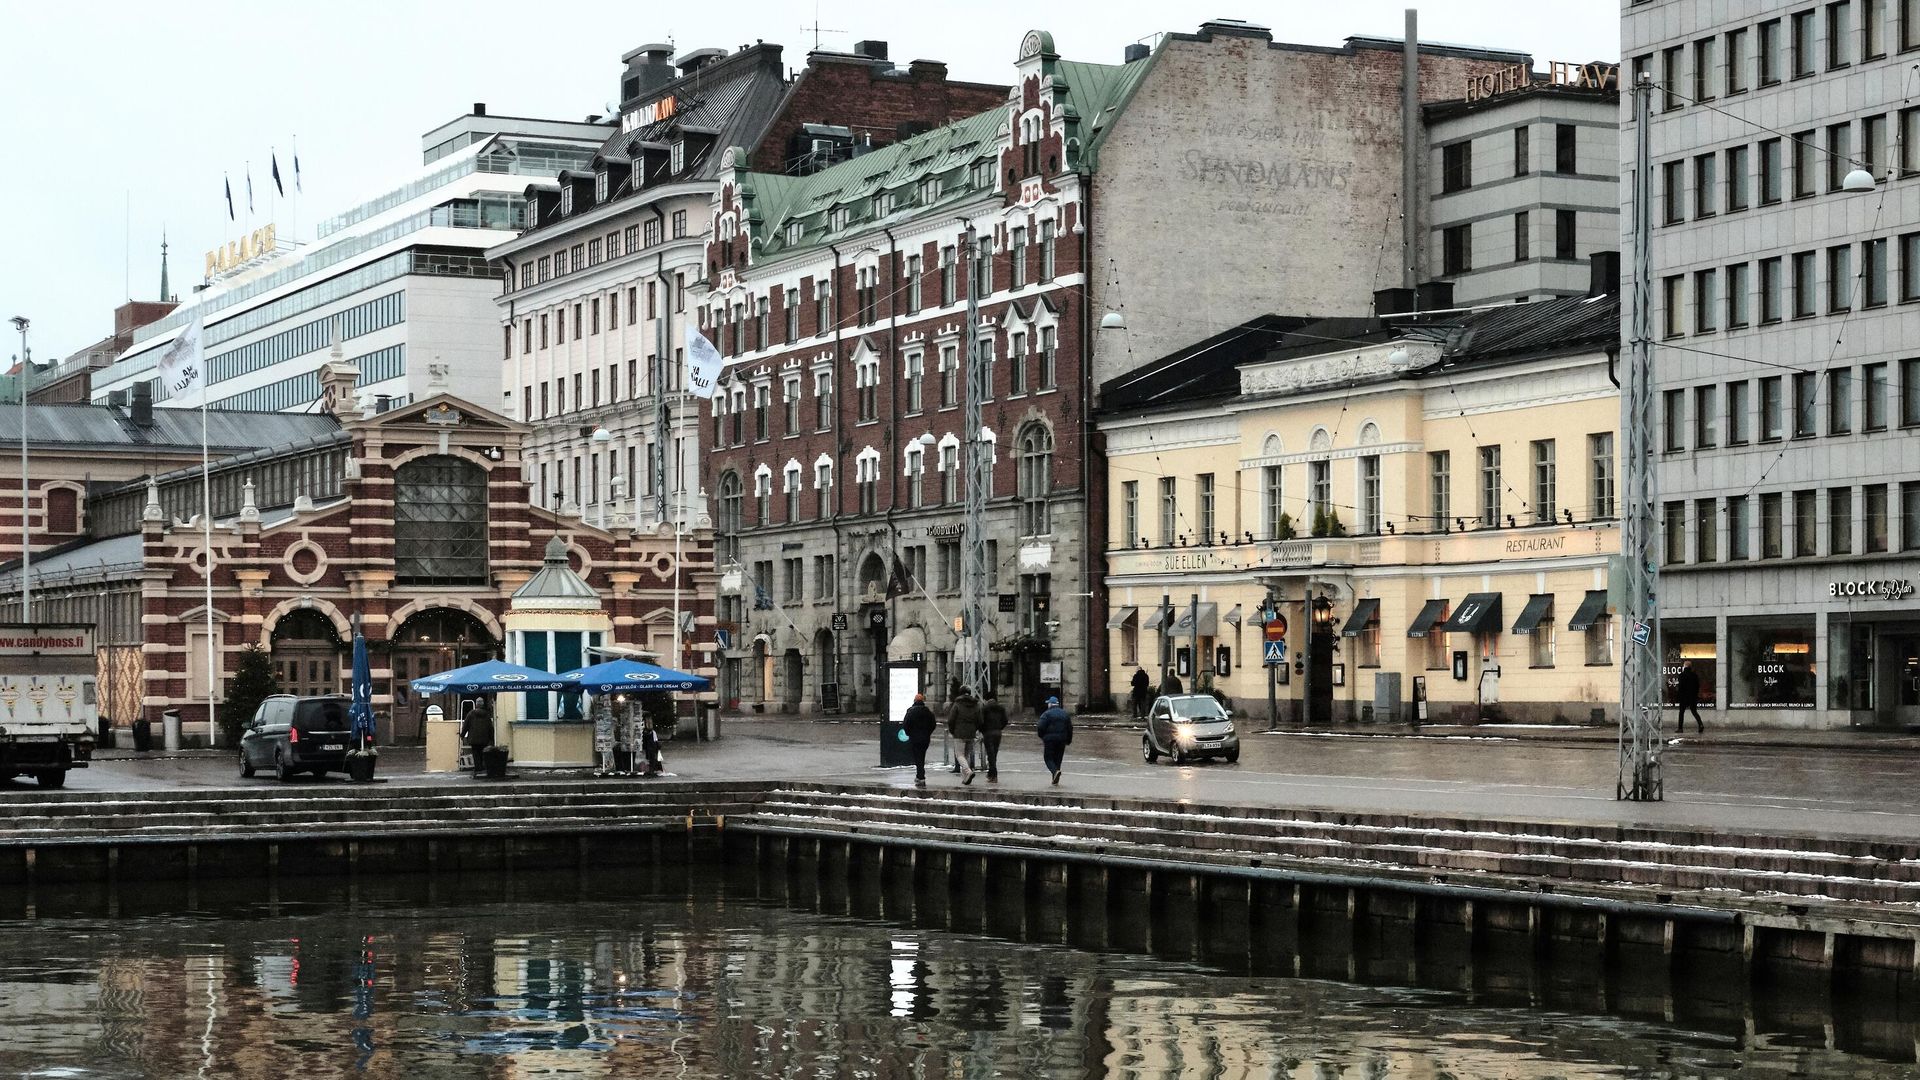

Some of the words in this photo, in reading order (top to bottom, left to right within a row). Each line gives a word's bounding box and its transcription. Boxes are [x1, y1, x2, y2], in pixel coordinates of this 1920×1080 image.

[1465, 63, 1531, 103] HOTEL
[205, 223, 275, 279] PALACE
[1506, 536, 1566, 553] RESTAURANT
[1165, 556, 1179, 570] SUE
[1182, 554, 1207, 569] ELLEN
[1829, 581, 1876, 596] BLOCK
[1881, 580, 1890, 600] by
[1891, 579, 1912, 600] Dylan
[1757, 664, 1784, 674] BLOCK
